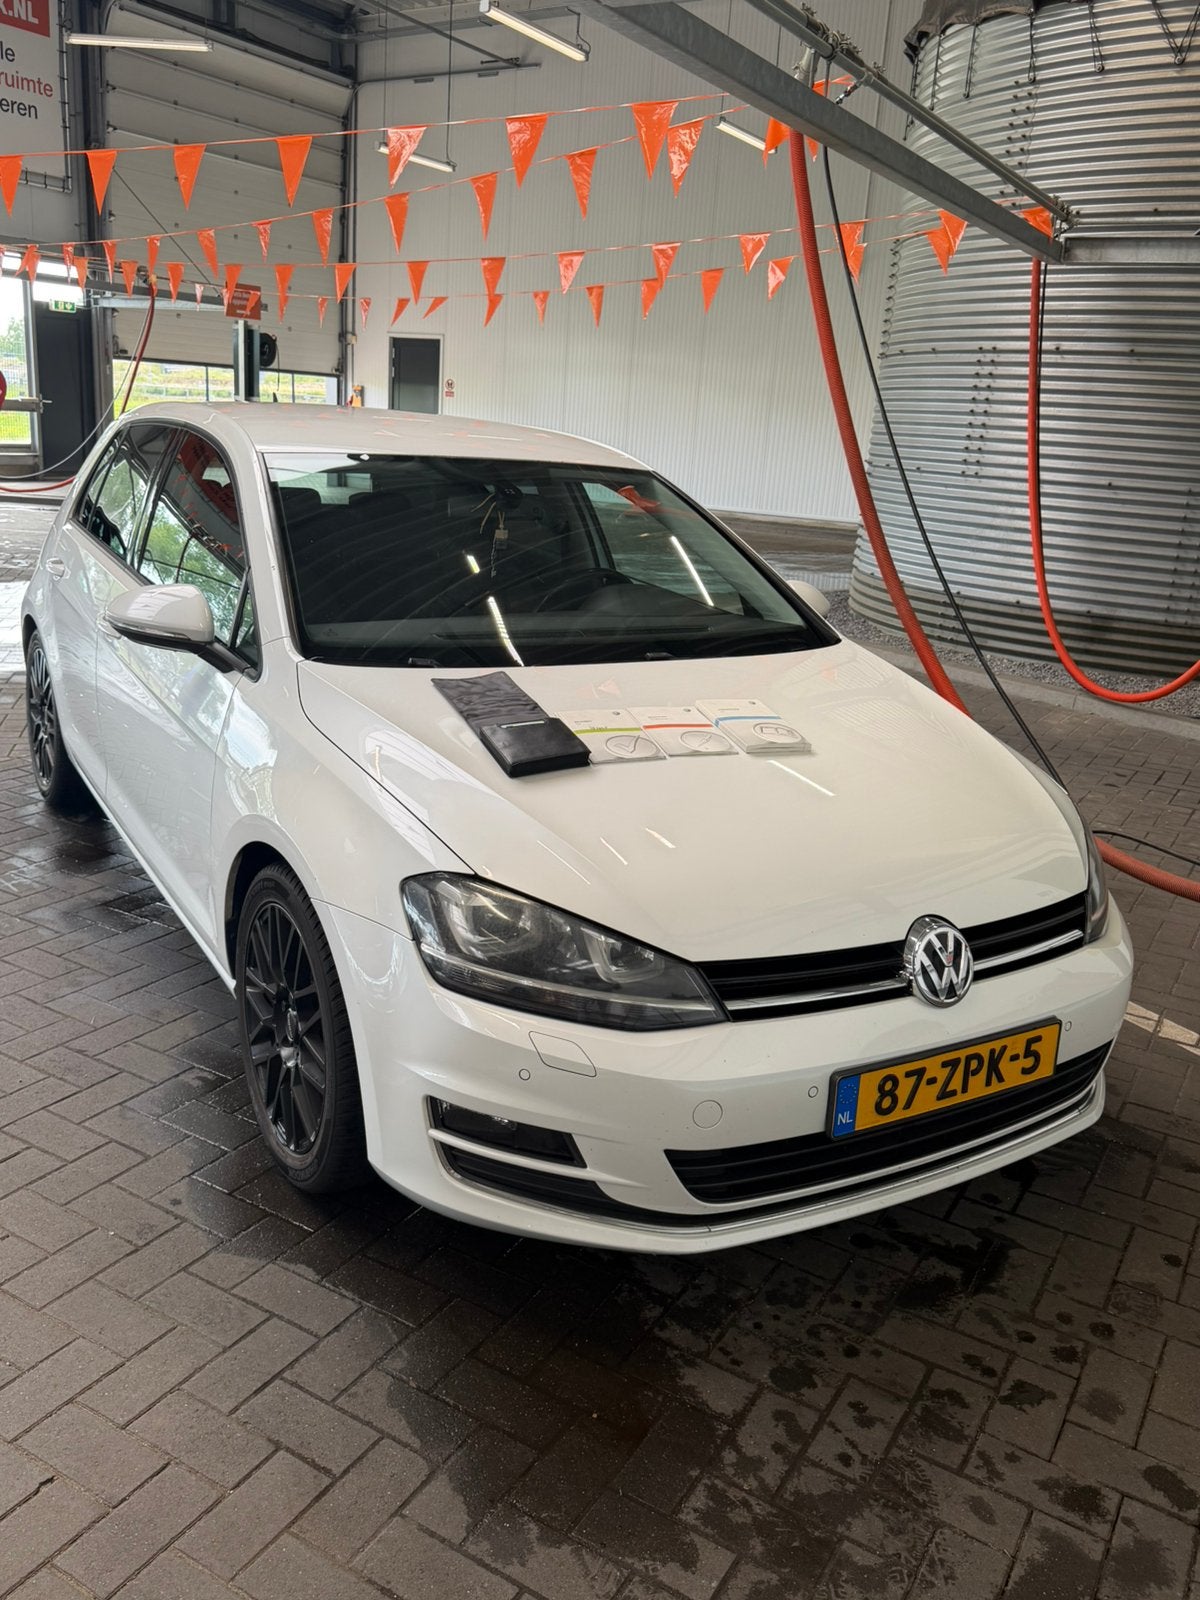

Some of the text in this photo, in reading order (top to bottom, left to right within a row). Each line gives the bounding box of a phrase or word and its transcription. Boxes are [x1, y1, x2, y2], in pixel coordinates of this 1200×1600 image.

[0, 71, 53, 98] ruimte
[0, 98, 38, 119] eren
[874, 1035, 1043, 1117] 87-ZPK-5
[837, 1112, 853, 1126] NL
